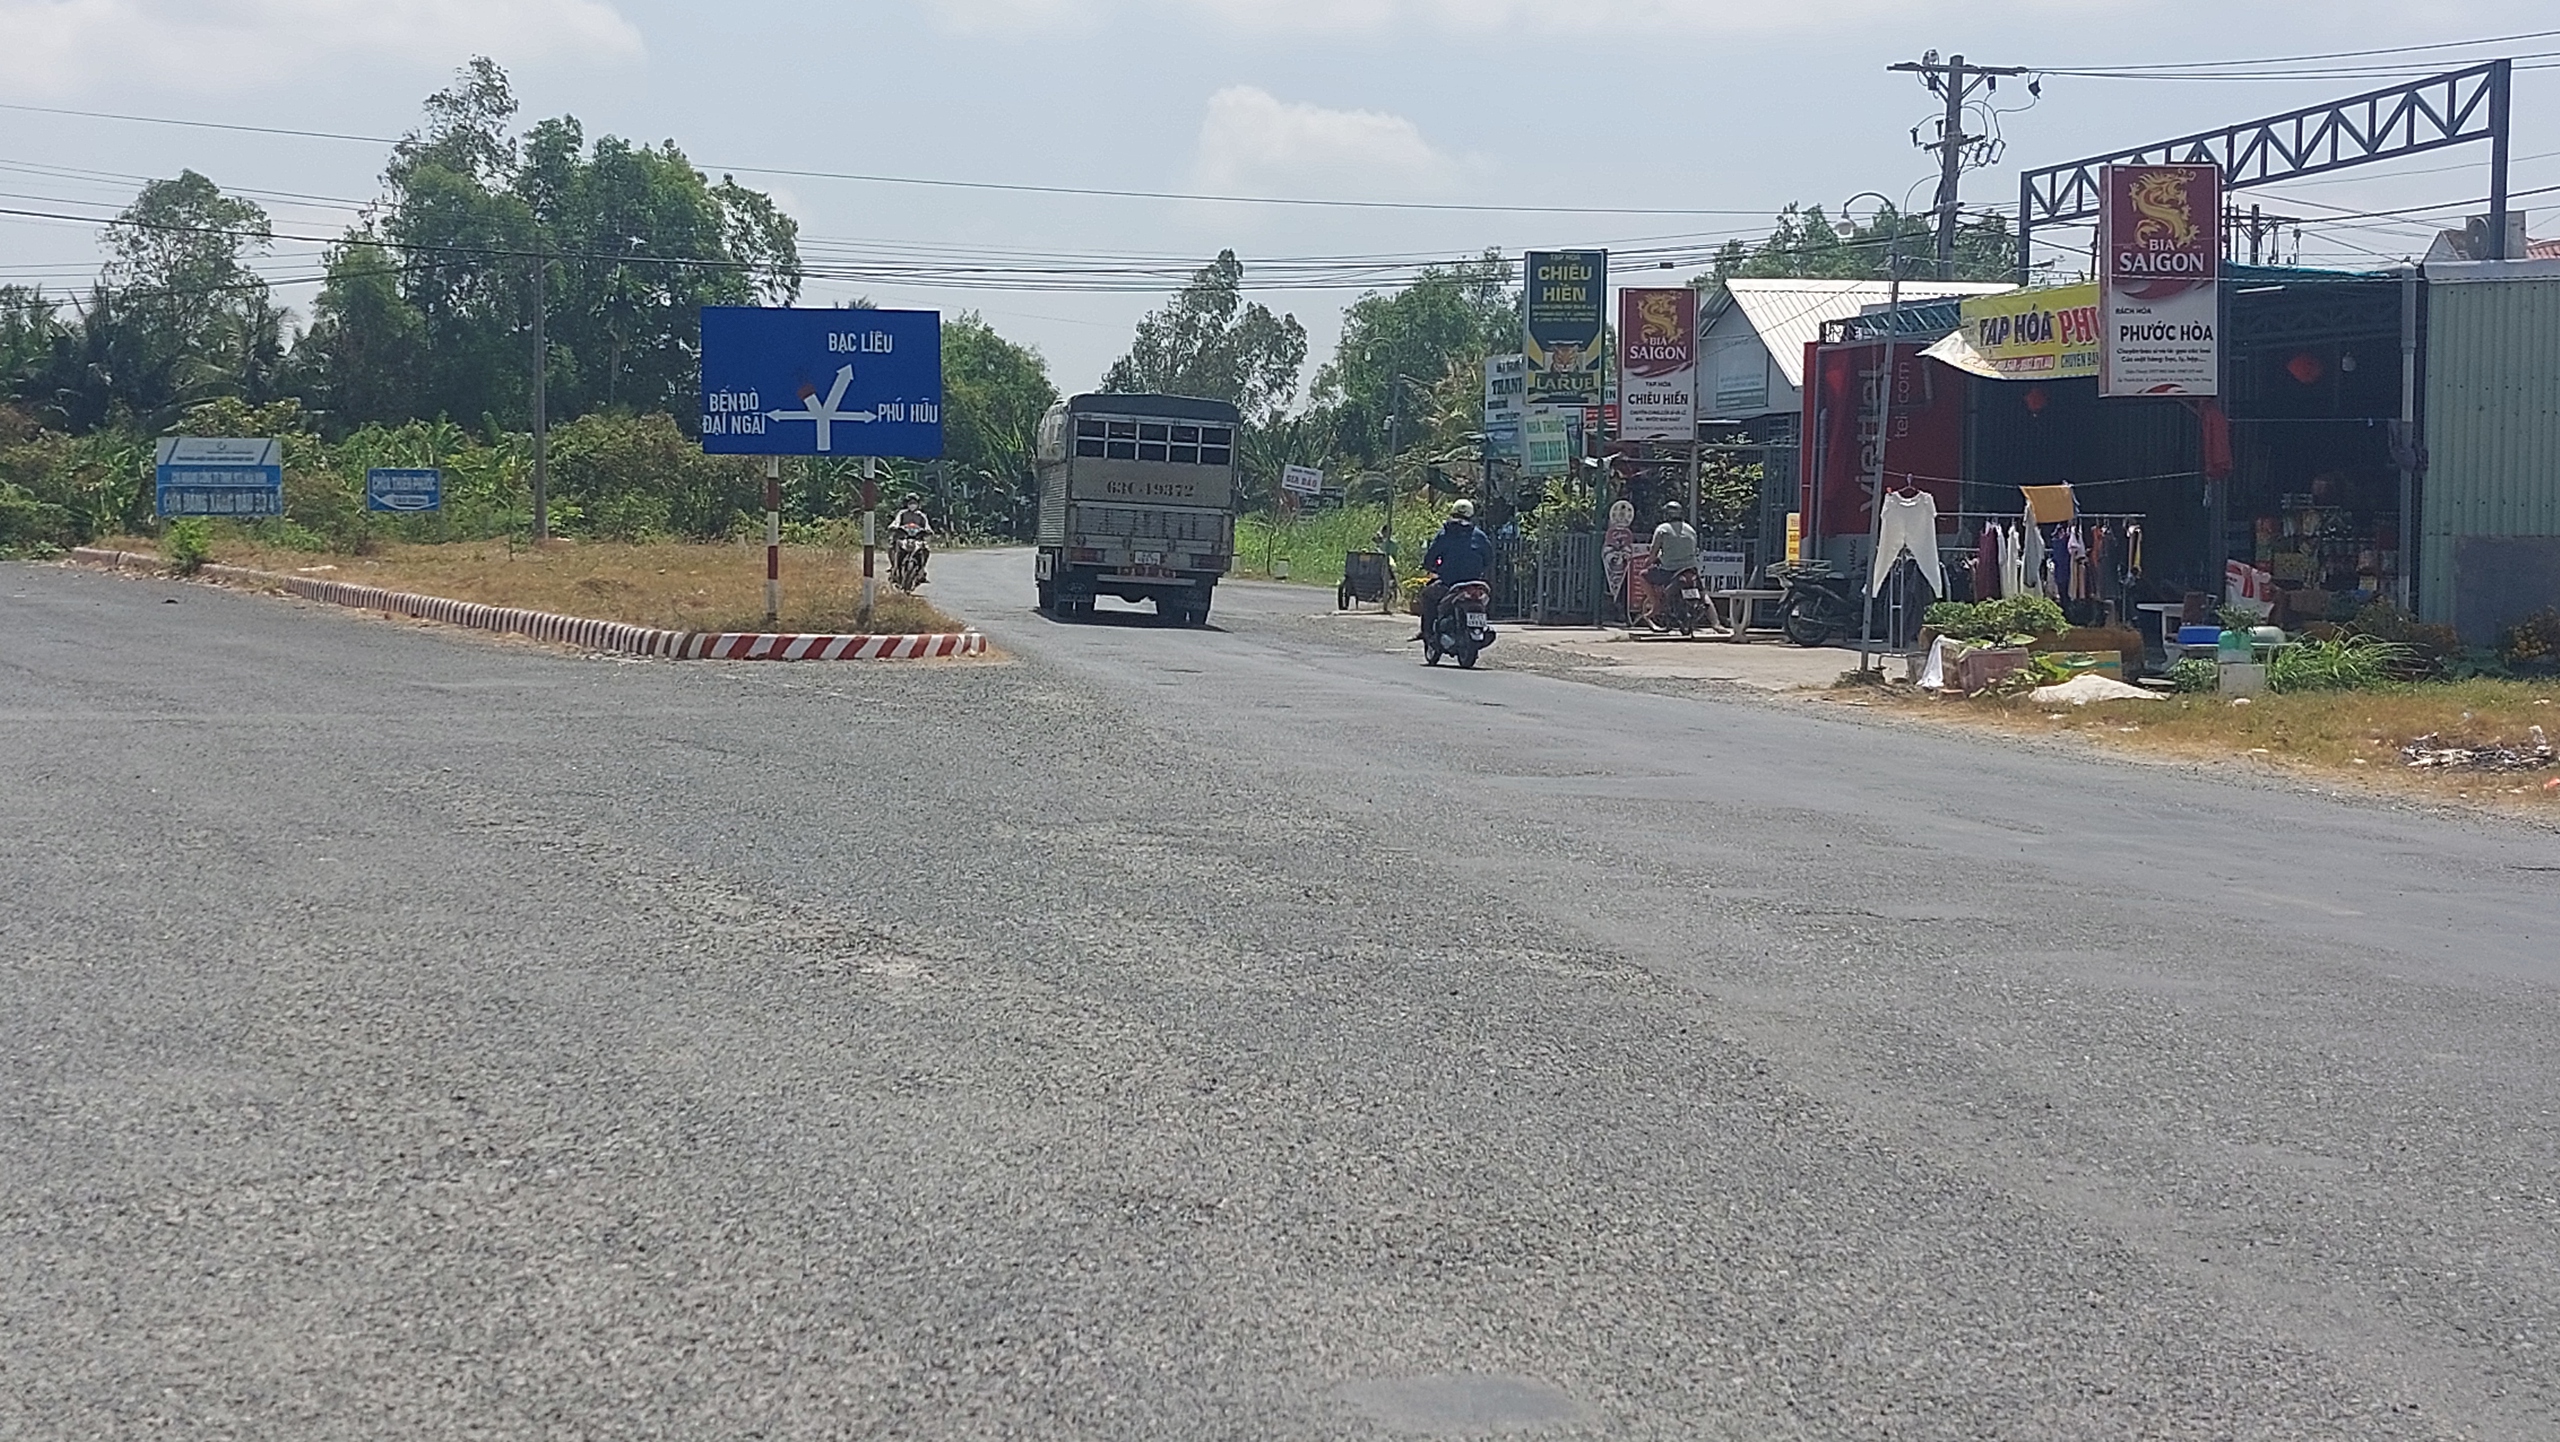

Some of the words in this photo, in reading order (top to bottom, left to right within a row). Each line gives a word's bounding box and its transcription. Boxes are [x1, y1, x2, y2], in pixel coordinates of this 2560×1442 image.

[2149, 239, 2175, 251] BIA
[1538, 263, 1592, 281] CHIÊU
[2119, 252, 2204, 272] SAIGON
[2120, 320, 2177, 342] PHƯỚC
[2180, 320, 2213, 342] HÒA
[828, 332, 857, 354] BẠC
[861, 330, 893, 354] LIÊU
[1629, 346, 1687, 360] SAIGON
[1536, 377, 1594, 391] LARUE
[739, 387, 759, 411] ĐÒ
[1628, 391, 1661, 405] CHIÊU
[877, 397, 905, 422] PHÚ
[910, 397, 939, 424] HỮU
[702, 414, 726, 437] ĐẠI
